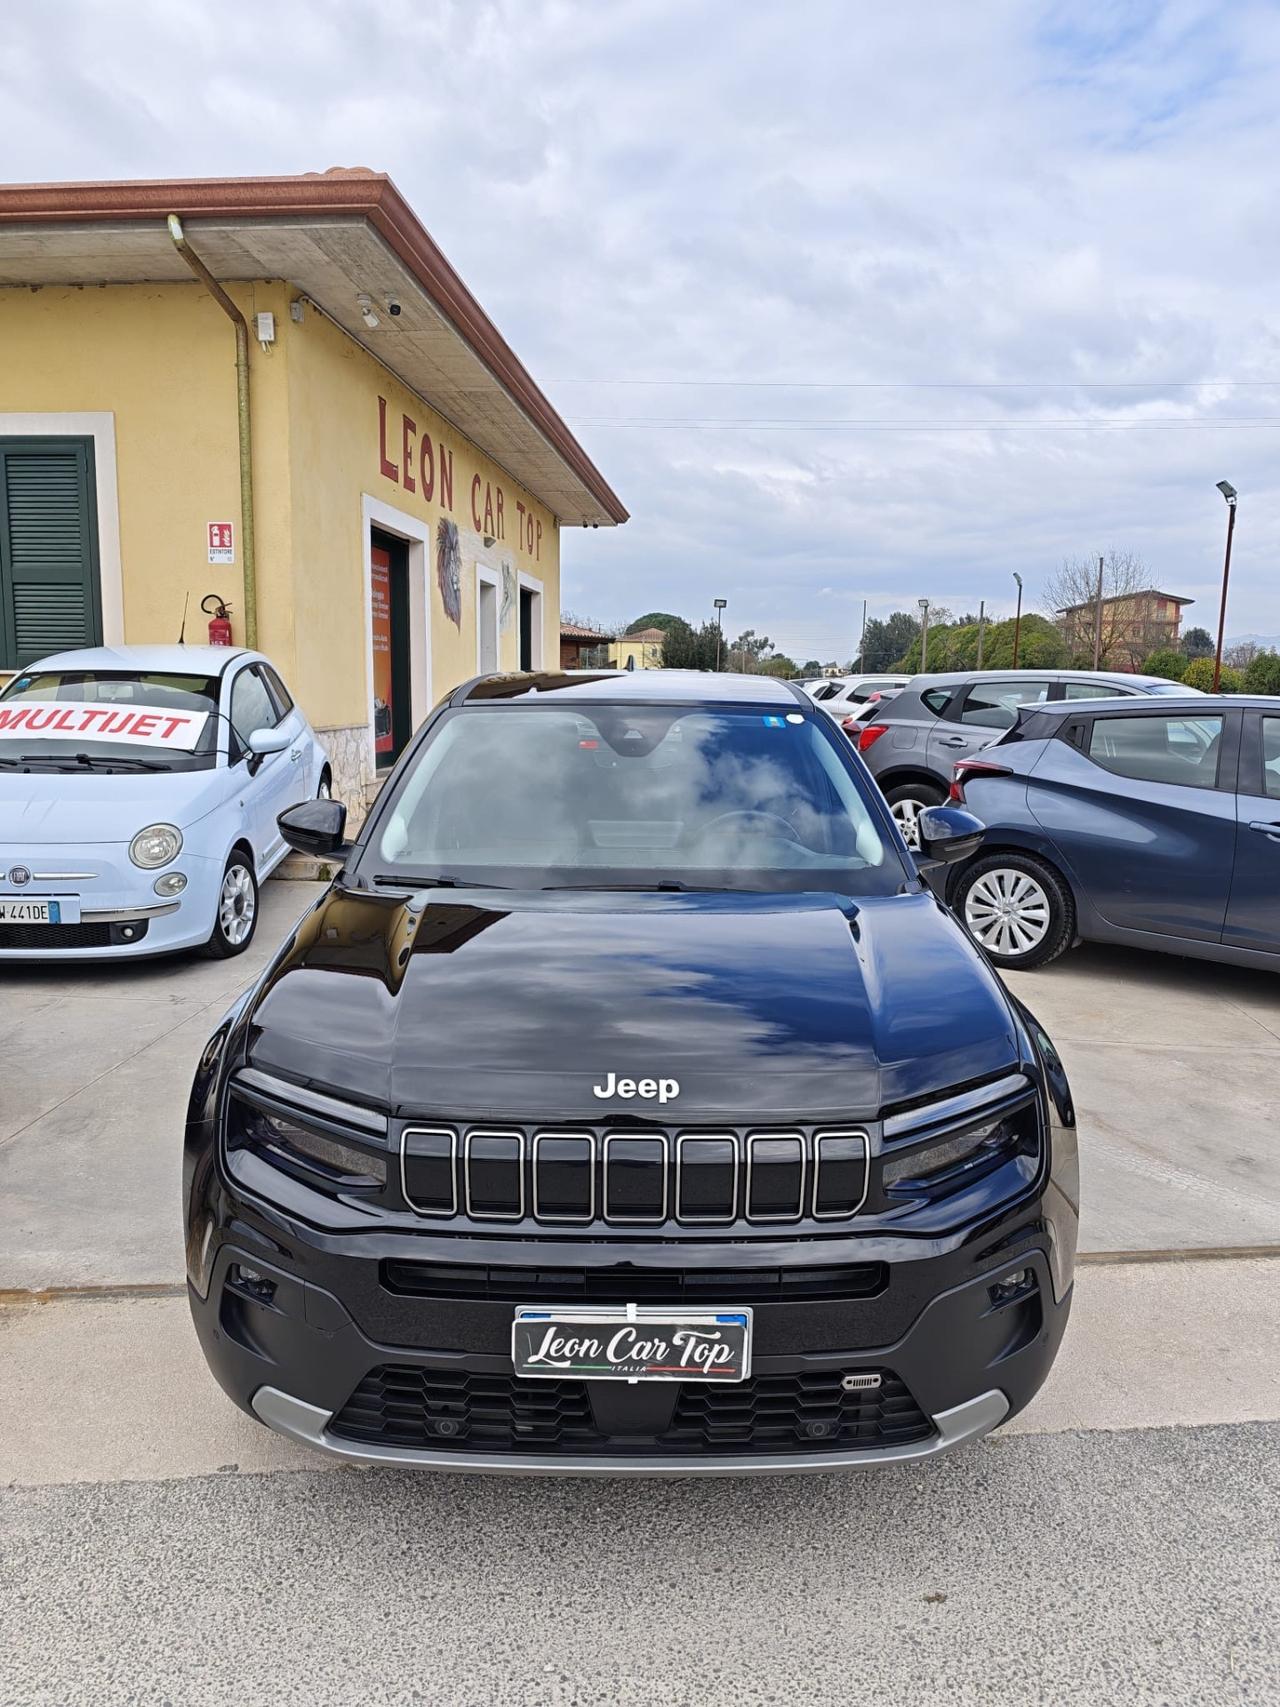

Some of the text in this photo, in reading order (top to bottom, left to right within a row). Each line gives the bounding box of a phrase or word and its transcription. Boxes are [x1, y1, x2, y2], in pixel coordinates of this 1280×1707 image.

[378, 395, 543, 562] LEON CAR TOP
[0, 708, 191, 739] MULTIJET
[592, 1072, 680, 1104] Jeep
[528, 1326, 735, 1374] Leon Car Top
[611, 1365, 648, 1373] ITALIA
